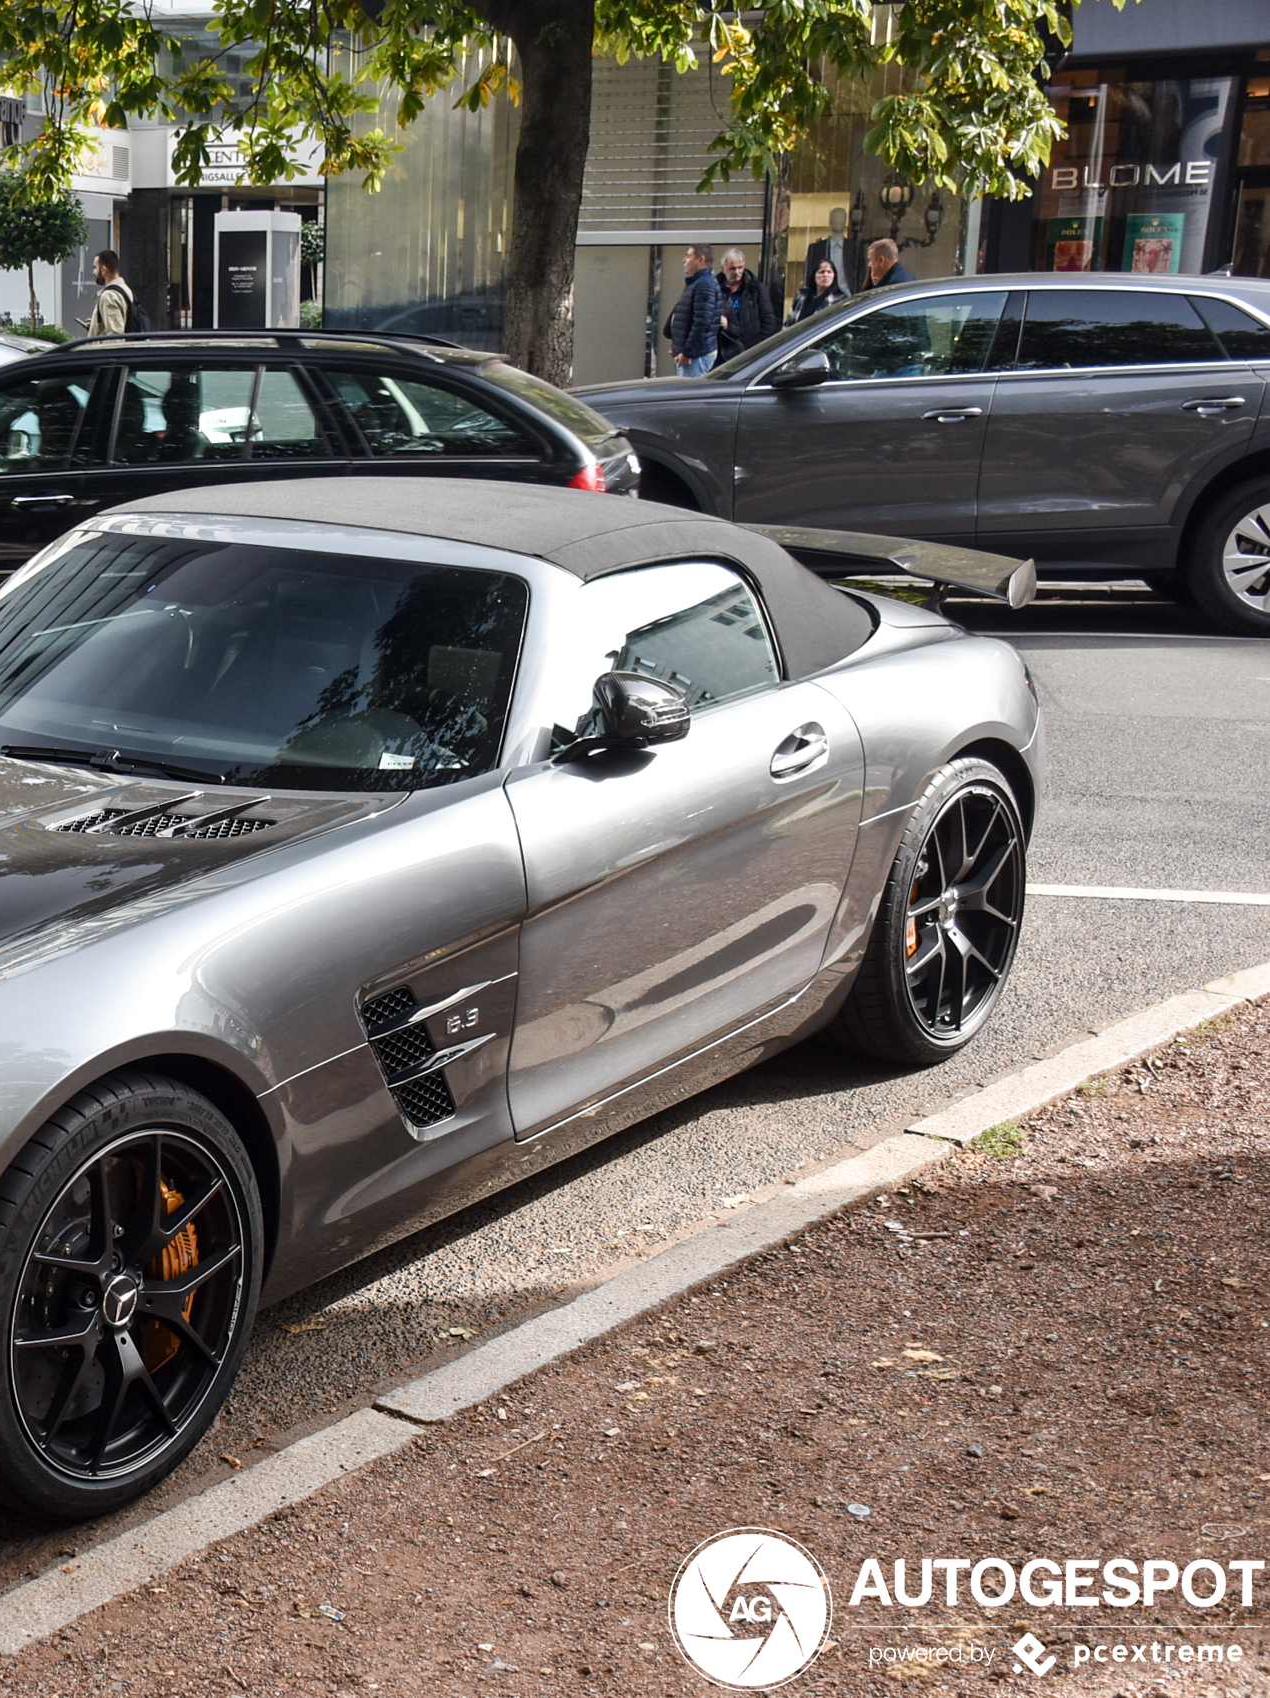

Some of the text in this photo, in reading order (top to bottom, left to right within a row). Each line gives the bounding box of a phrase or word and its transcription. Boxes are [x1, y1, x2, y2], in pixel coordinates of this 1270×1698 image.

[1051, 160, 1212, 190] BLOME
[446, 1007, 479, 1034] 6.3
[21, 1119, 102, 1228] MICHELIN
